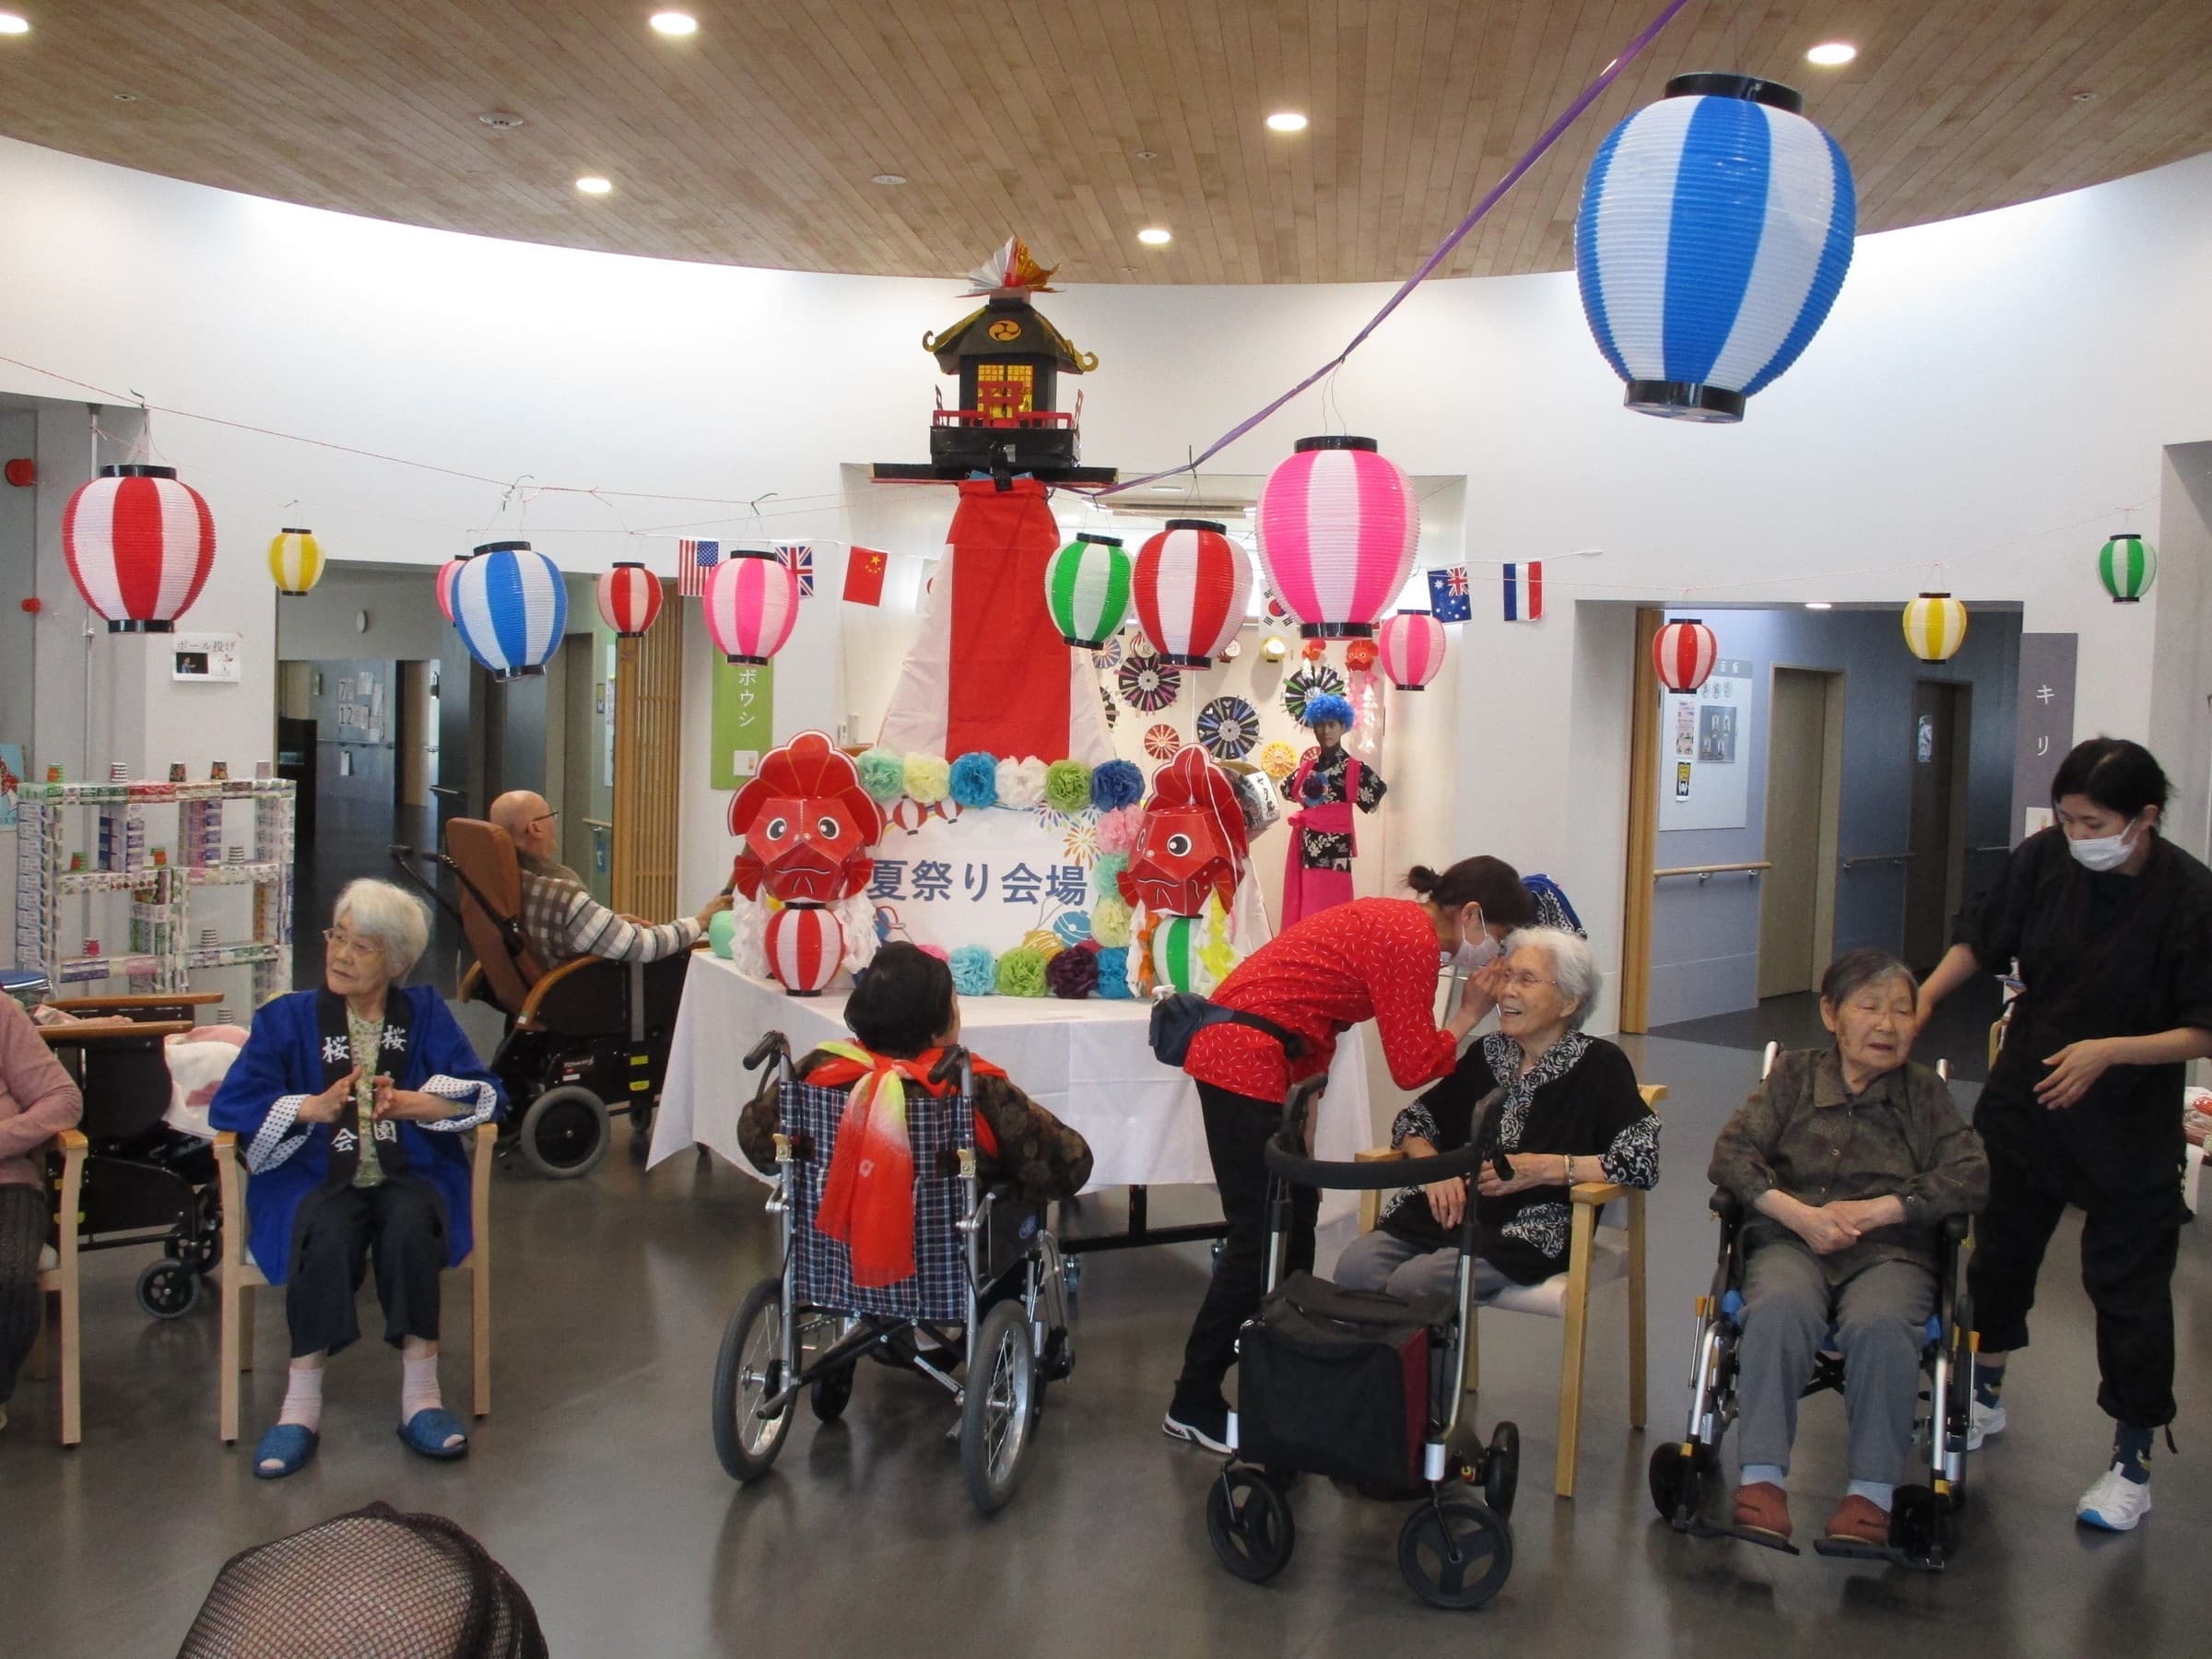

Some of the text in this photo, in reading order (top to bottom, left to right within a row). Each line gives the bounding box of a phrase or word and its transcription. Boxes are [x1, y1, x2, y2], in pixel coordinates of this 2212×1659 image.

[738, 669, 756, 727] ボウシ
[2036, 684, 2055, 756] キリ
[866, 859, 1088, 906] 夏祭り会場
[323, 1035, 359, 1152] 桜会
